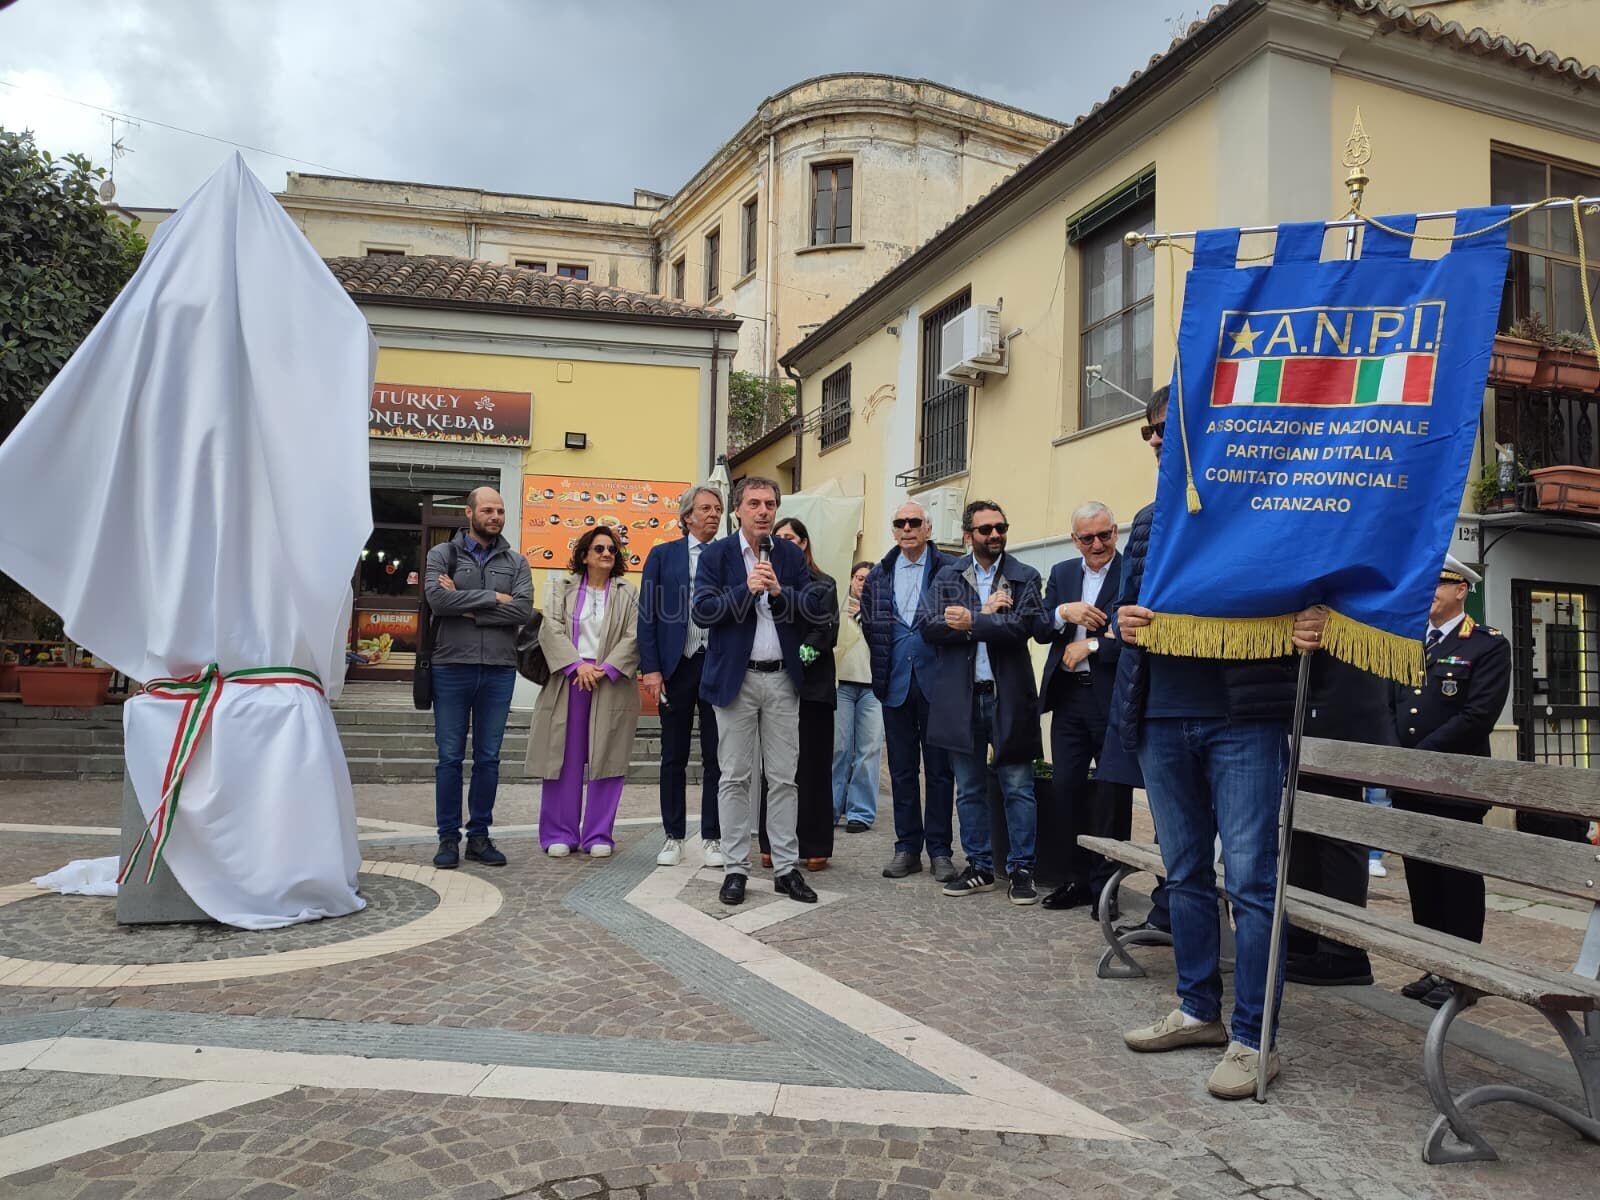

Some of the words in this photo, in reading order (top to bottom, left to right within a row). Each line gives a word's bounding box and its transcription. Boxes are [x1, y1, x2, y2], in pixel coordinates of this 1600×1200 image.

[1263, 307, 1433, 355] A.N.P.I.
[374, 390, 462, 410] TURKEY
[426, 413, 495, 433] KEBAB
[1206, 419, 1325, 435] ASSOCIAZIONE
[1328, 419, 1430, 435] NAZIONALE
[1226, 444, 1318, 460] PARTIGIANI
[1322, 445, 1394, 460] D'ITALIA
[1205, 468, 1289, 485] COMITATO
[1292, 471, 1409, 489] PROVINCIALE
[1250, 496, 1351, 513] CATANZARO
